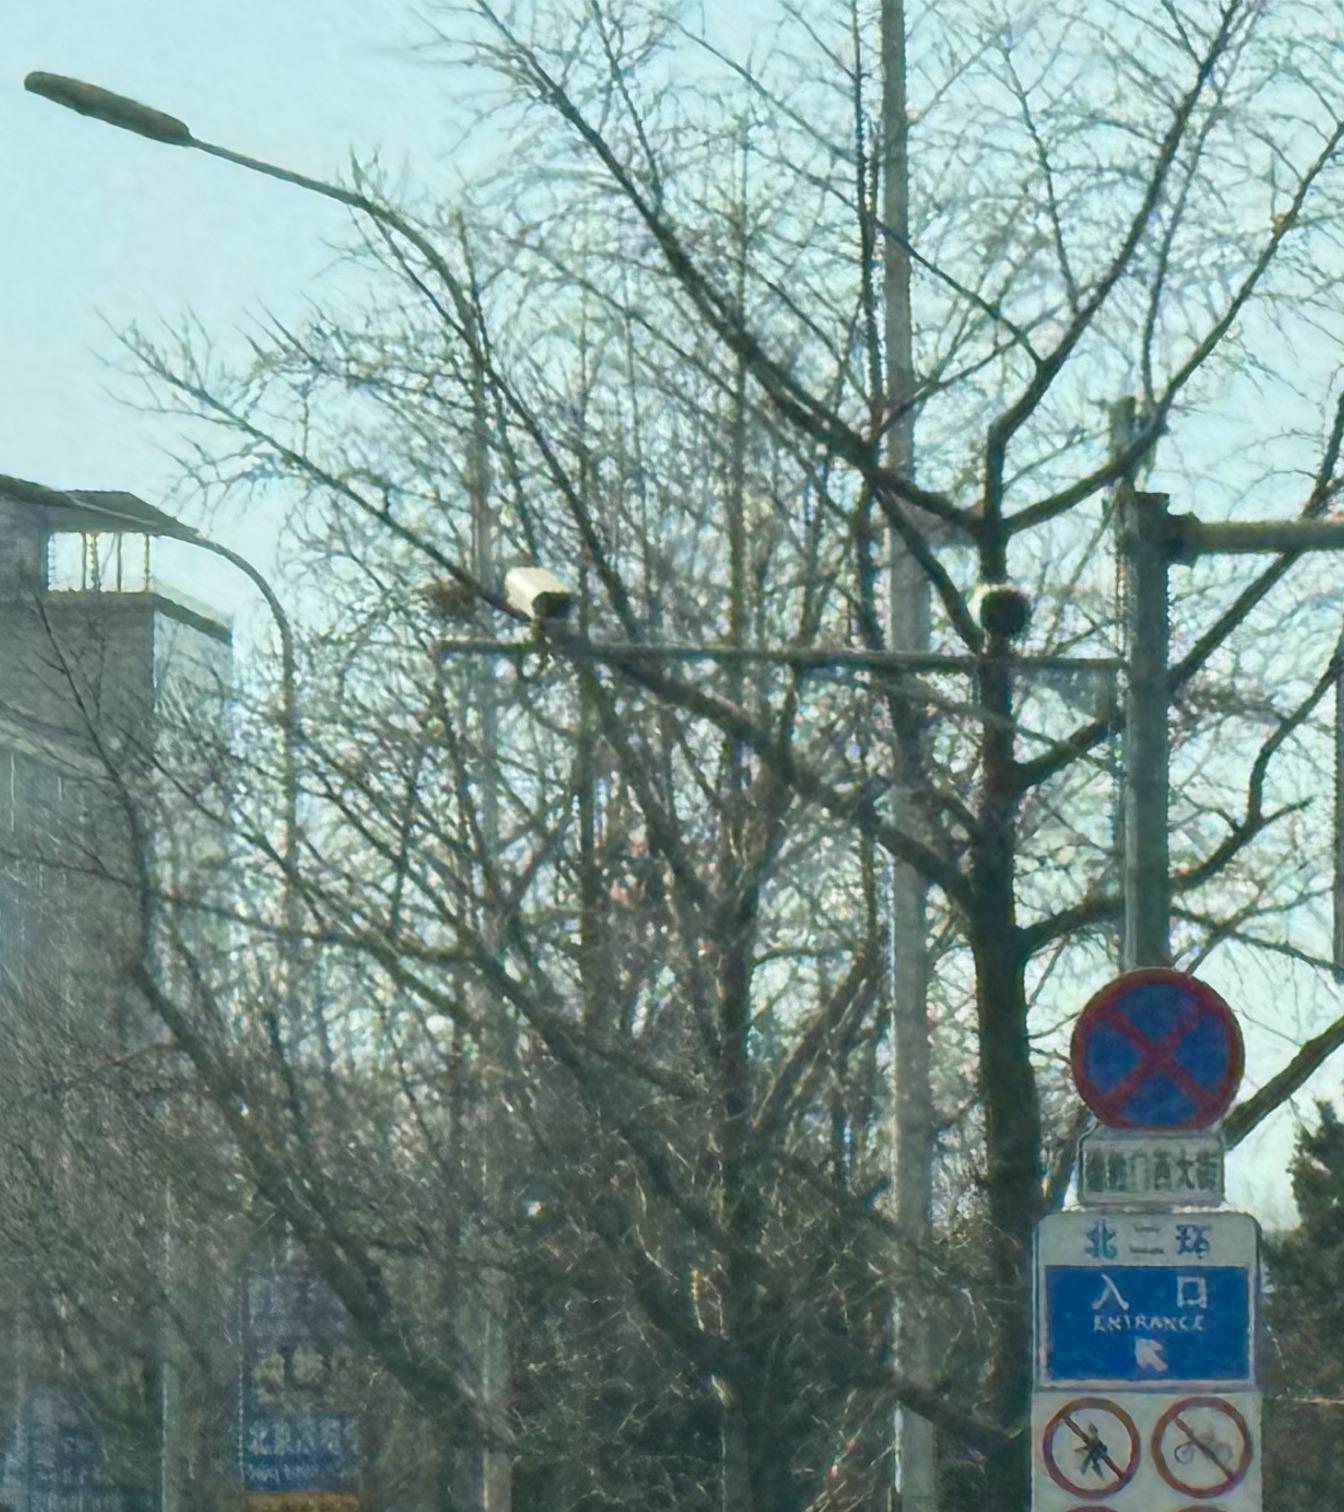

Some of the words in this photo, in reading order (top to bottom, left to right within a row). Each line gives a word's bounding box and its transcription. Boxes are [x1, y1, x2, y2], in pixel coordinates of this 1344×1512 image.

[1085, 1220, 1211, 1260] 北二环
[1092, 1273, 1207, 1311] 入口
[1092, 1314, 1206, 1332] ENTRANCE
